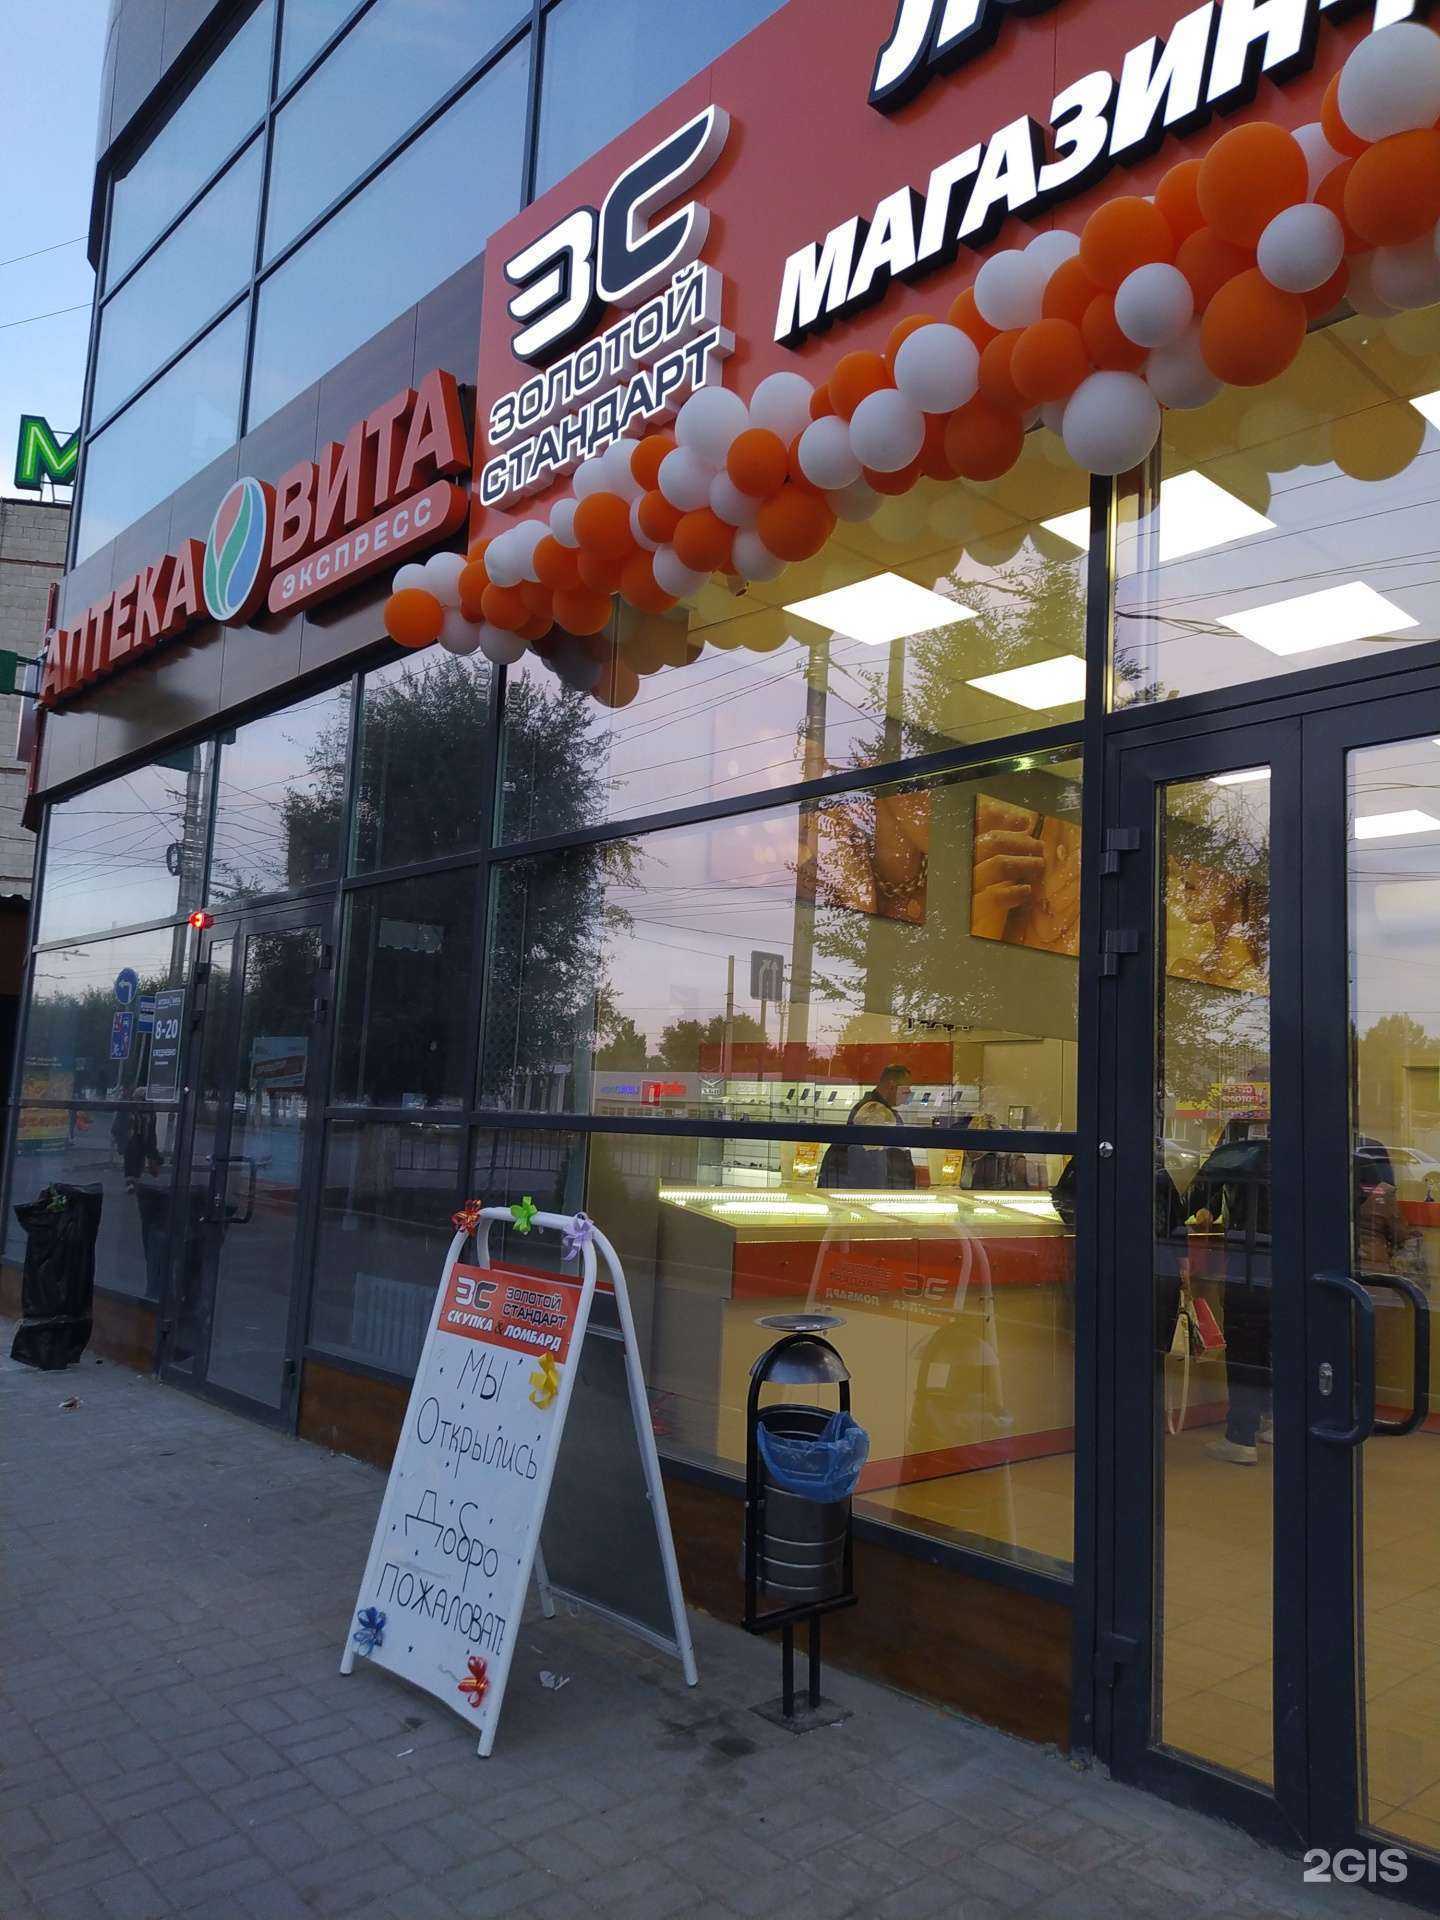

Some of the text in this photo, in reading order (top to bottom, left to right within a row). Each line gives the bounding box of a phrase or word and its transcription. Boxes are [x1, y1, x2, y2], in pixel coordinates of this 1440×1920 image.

[773, 0, 1310, 344] МАГАЗИН
[480, 327, 721, 507] СТАНДАРТ
[488, 262, 709, 446] ЗОЛОТОЙ
[271, 368, 464, 569] ВИТА
[281, 497, 433, 600] ЭКСПРЕСС
[40, 538, 207, 700] АПТЕКА
[154, 1018, 179, 1040] 8-20
[447, 1309, 494, 1332] СКУПКА
[503, 1325, 562, 1352] ЛОМБАРД
[502, 1303, 567, 1330] СТАНДАРТ
[505, 1287, 563, 1312] ЗОЛОТОЙ
